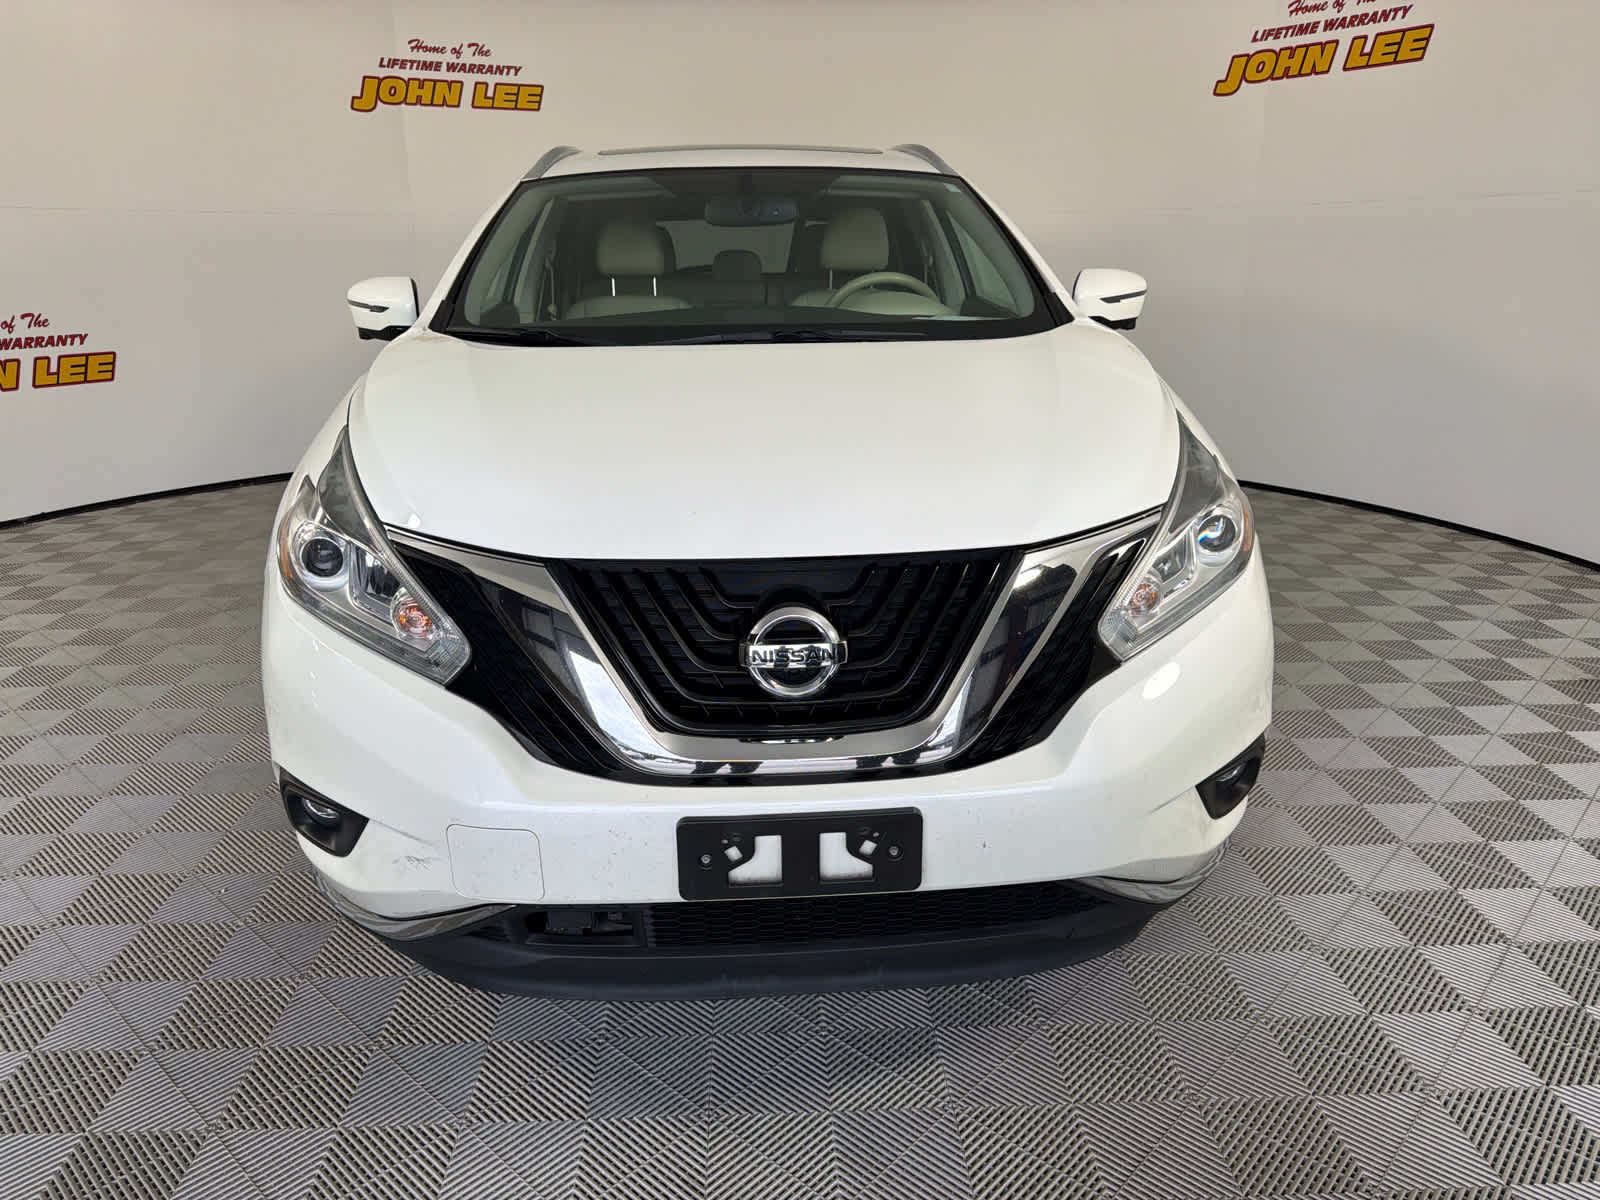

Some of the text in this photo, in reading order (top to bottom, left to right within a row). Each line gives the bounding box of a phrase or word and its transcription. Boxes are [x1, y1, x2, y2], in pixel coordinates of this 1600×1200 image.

[1288, 0, 1345, 16] Home of
[1251, 4, 1413, 43] LIFETIME WARRANTY
[408, 38, 492, 58] Home of The
[378, 57, 522, 76] LIFETIME WARRANTY
[1213, 24, 1434, 96] JOHN LEE
[351, 75, 544, 112] JOHN LEE
[0, 313, 50, 334] of The
[0, 333, 88, 350] WARRANTY
[32, 351, 116, 389] LEE
[751, 647, 838, 663] NISSAN
